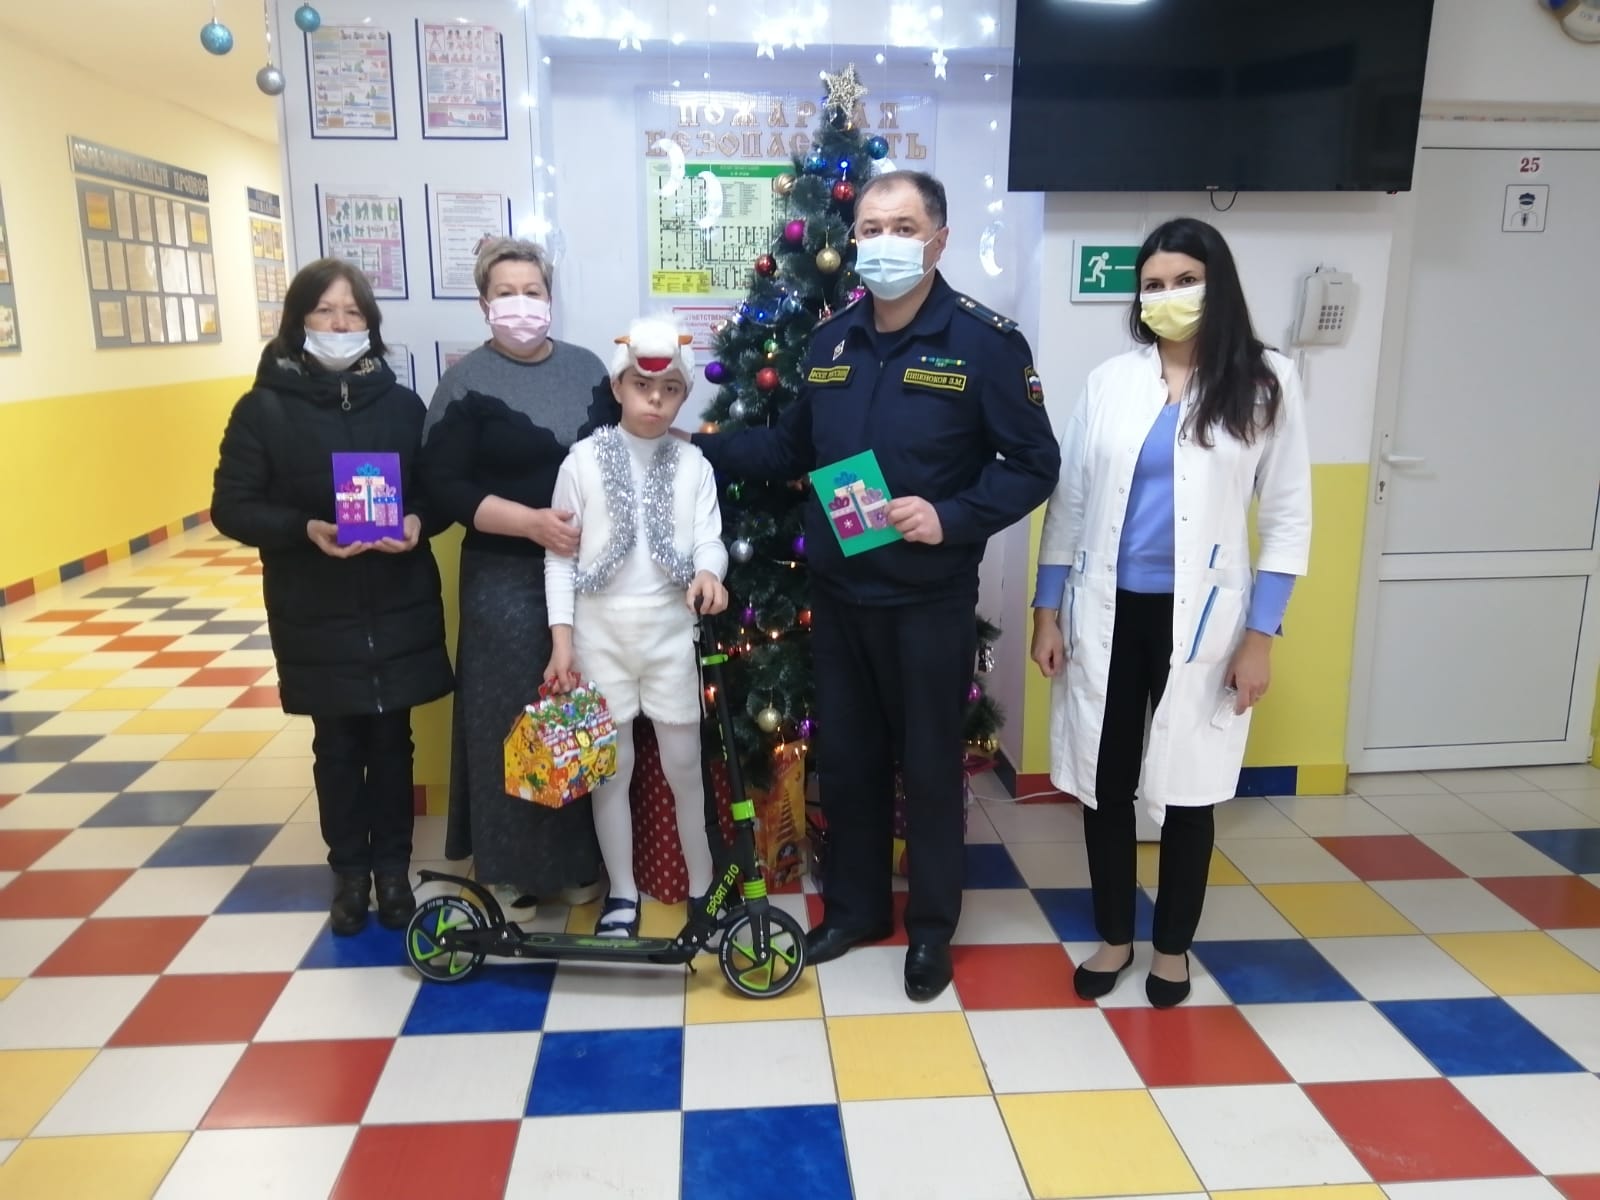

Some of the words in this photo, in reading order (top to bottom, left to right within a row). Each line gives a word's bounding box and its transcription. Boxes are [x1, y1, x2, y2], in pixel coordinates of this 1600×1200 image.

[678, 100, 899, 129] ПОЖАРАЯ
[645, 130, 927, 159] БЕЗОПАСТЬ
[1520, 157, 1540, 173] 25
[706, 883, 728, 917] SPORT
